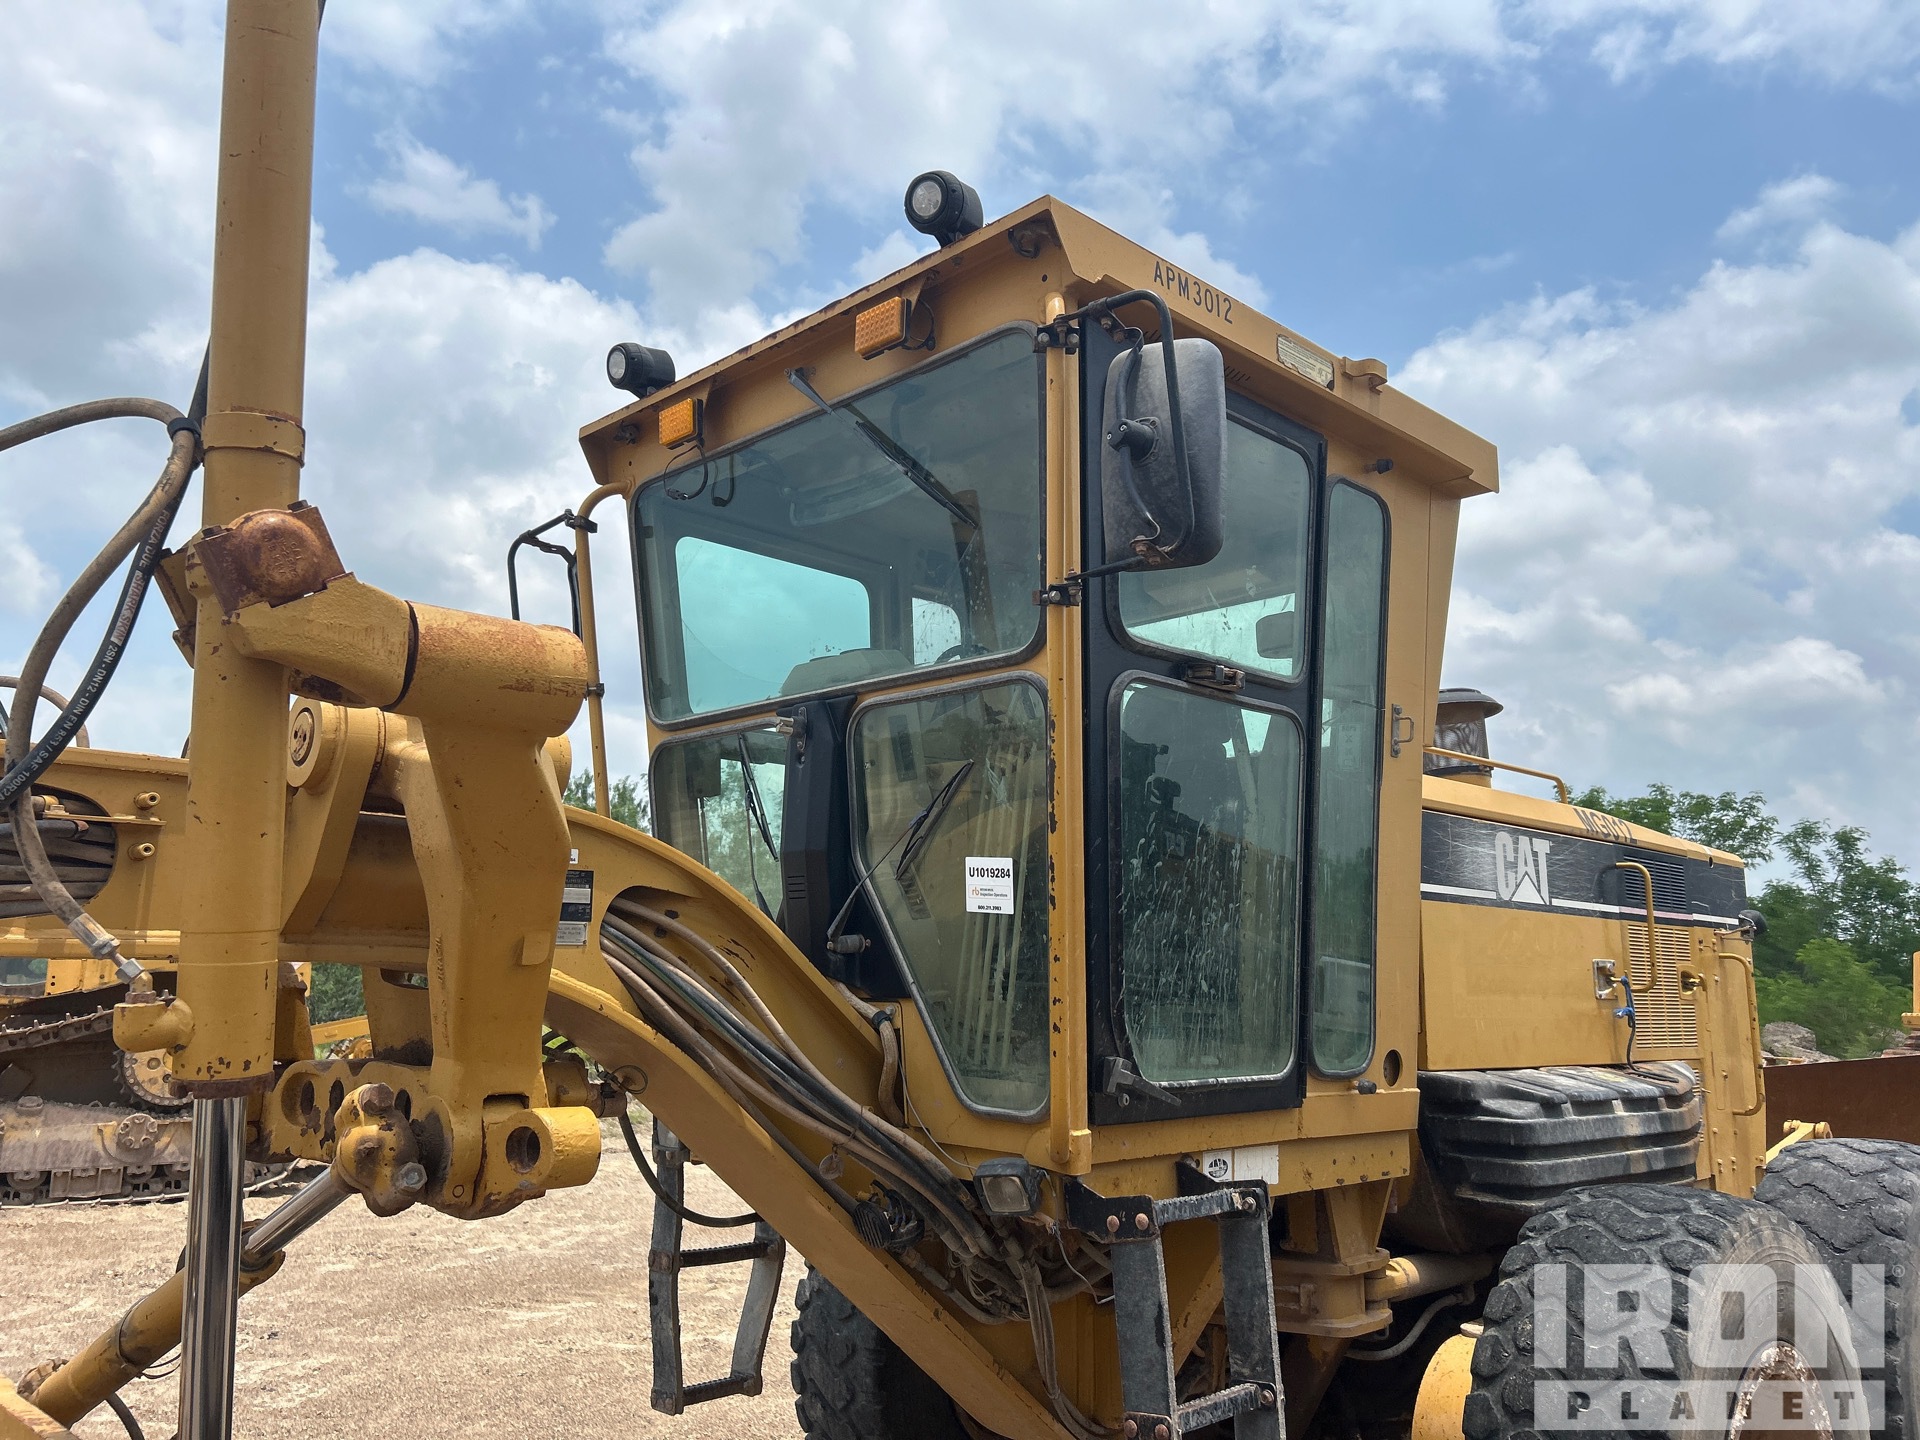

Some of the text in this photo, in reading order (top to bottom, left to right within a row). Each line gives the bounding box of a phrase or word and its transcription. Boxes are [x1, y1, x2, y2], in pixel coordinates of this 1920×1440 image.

[1153, 260, 1233, 325] APM3012
[148, 509, 171, 544] FORZA
[138, 545, 156, 568] DUE
[124, 574, 145, 614] SHARK
[114, 613, 131, 643] SKIN
[104, 644, 118, 664] 2SN
[87, 668, 107, 693] DN12
[73, 697, 90, 715] DIN
[63, 714, 78, 730] EN
[1573, 807, 1638, 845] MG012
[968, 866, 1010, 878] U1019284
[1495, 831, 1551, 905] CAT
